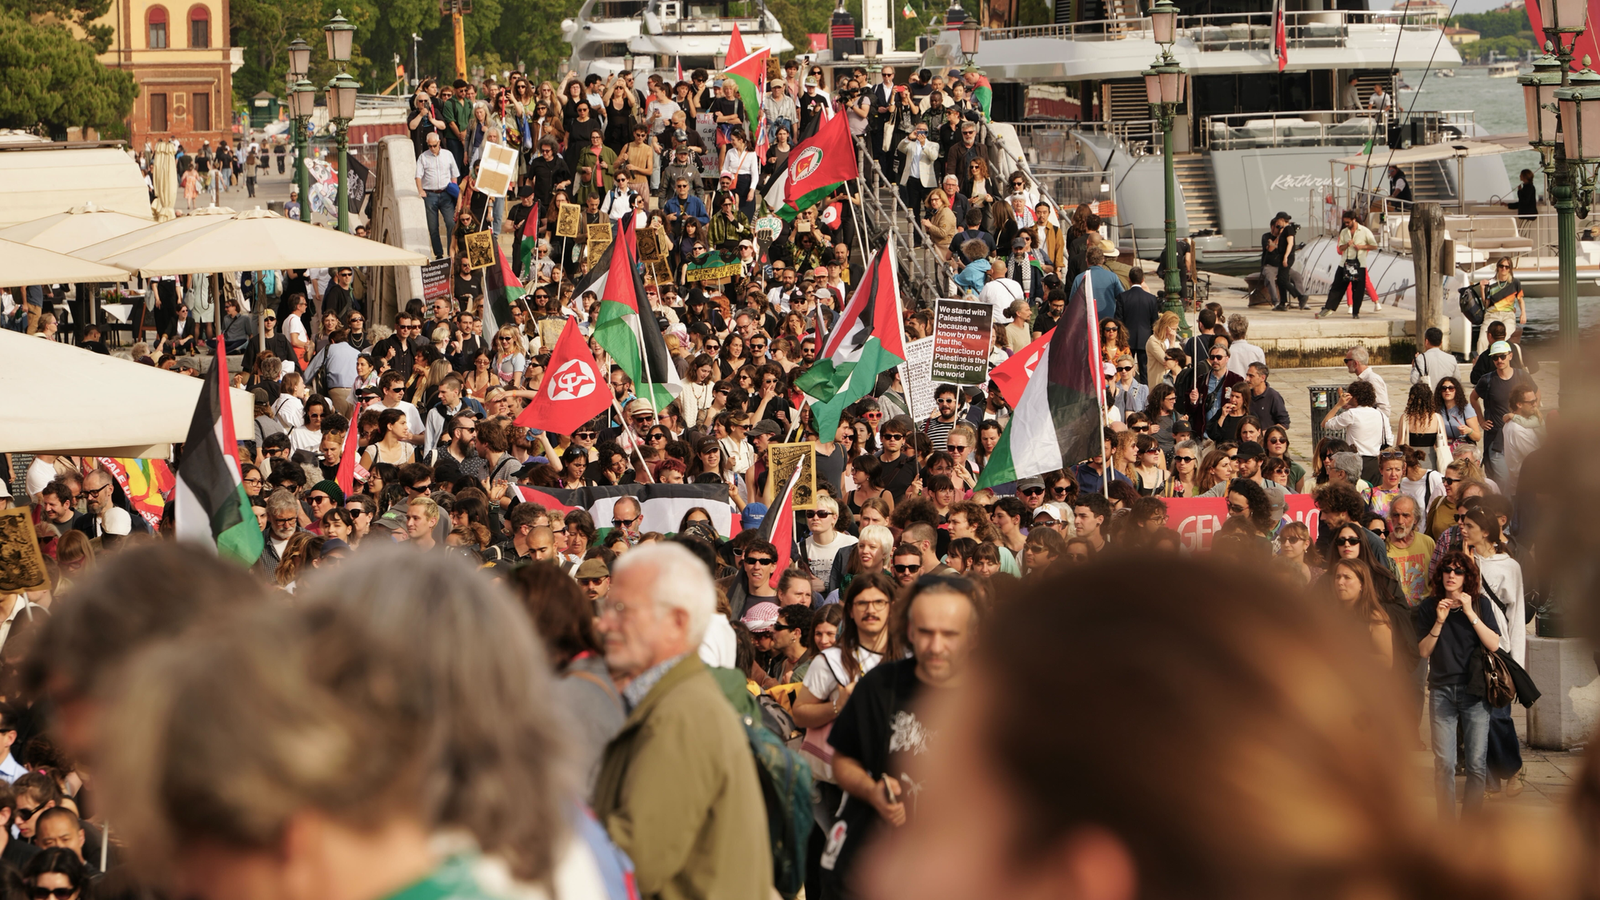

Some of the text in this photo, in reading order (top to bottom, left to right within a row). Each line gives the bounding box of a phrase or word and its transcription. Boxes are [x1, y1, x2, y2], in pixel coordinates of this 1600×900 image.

[951, 307, 970, 315] stand
[939, 314, 971, 323] Palestine
[938, 322, 967, 330] because
[937, 330, 956, 338] know
[936, 346, 975, 355] destruction
[935, 353, 966, 362] Palestine
[934, 362, 973, 371] destruction
[98, 457, 126, 484] CALE
